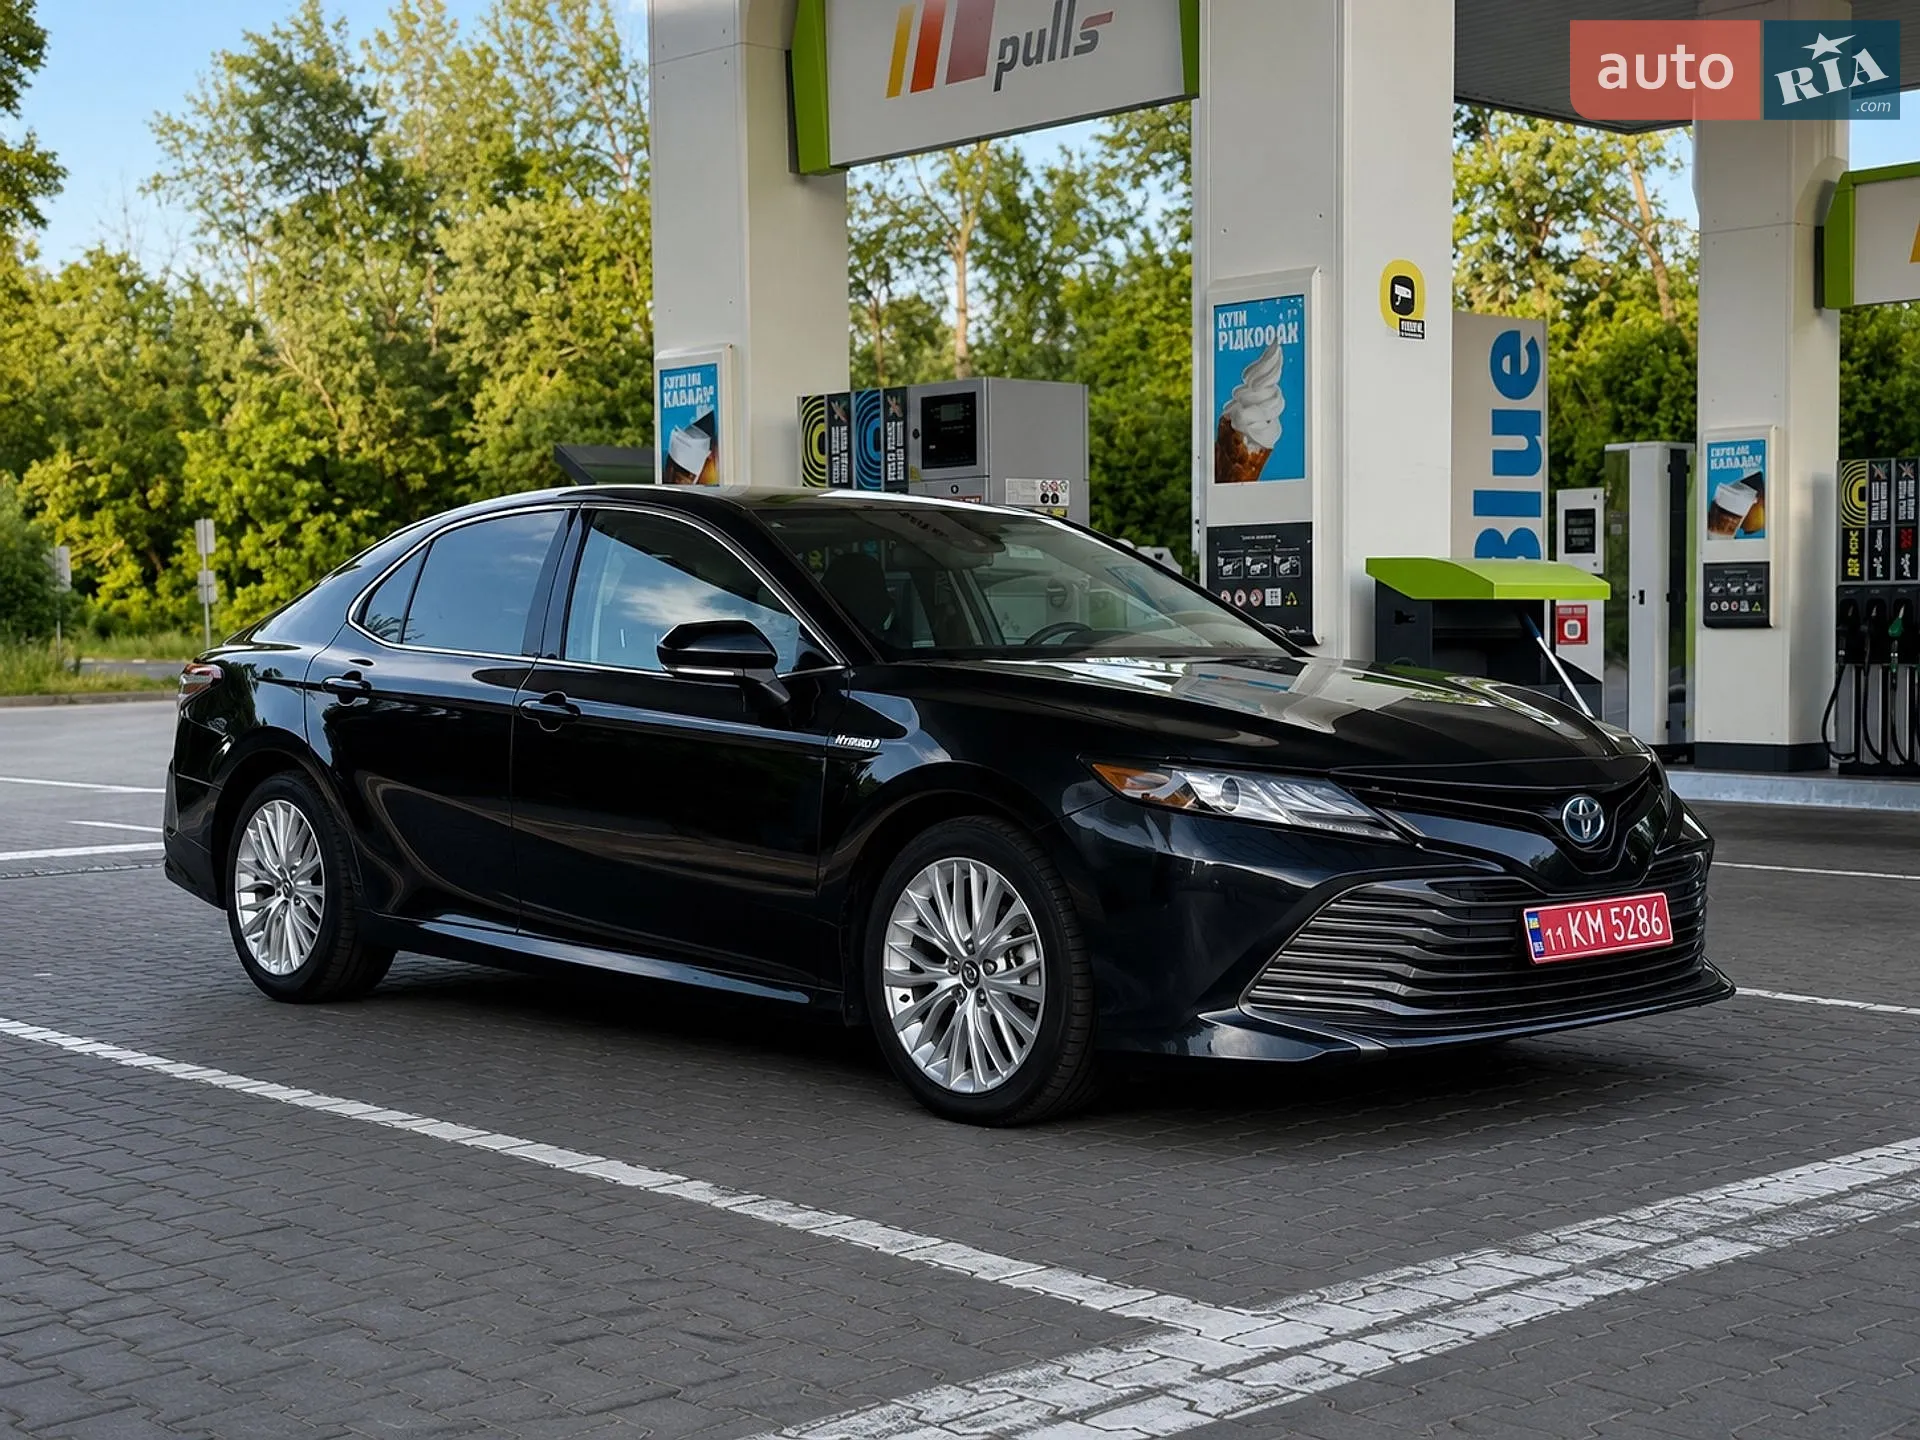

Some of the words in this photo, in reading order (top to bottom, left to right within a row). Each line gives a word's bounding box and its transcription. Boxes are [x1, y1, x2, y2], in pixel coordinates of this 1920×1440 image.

[993, 0, 1114, 92] pulls
[1545, 926, 1567, 951] 11
[1567, 908, 1607, 948] KM
[1610, 901, 1664, 942] 5286
